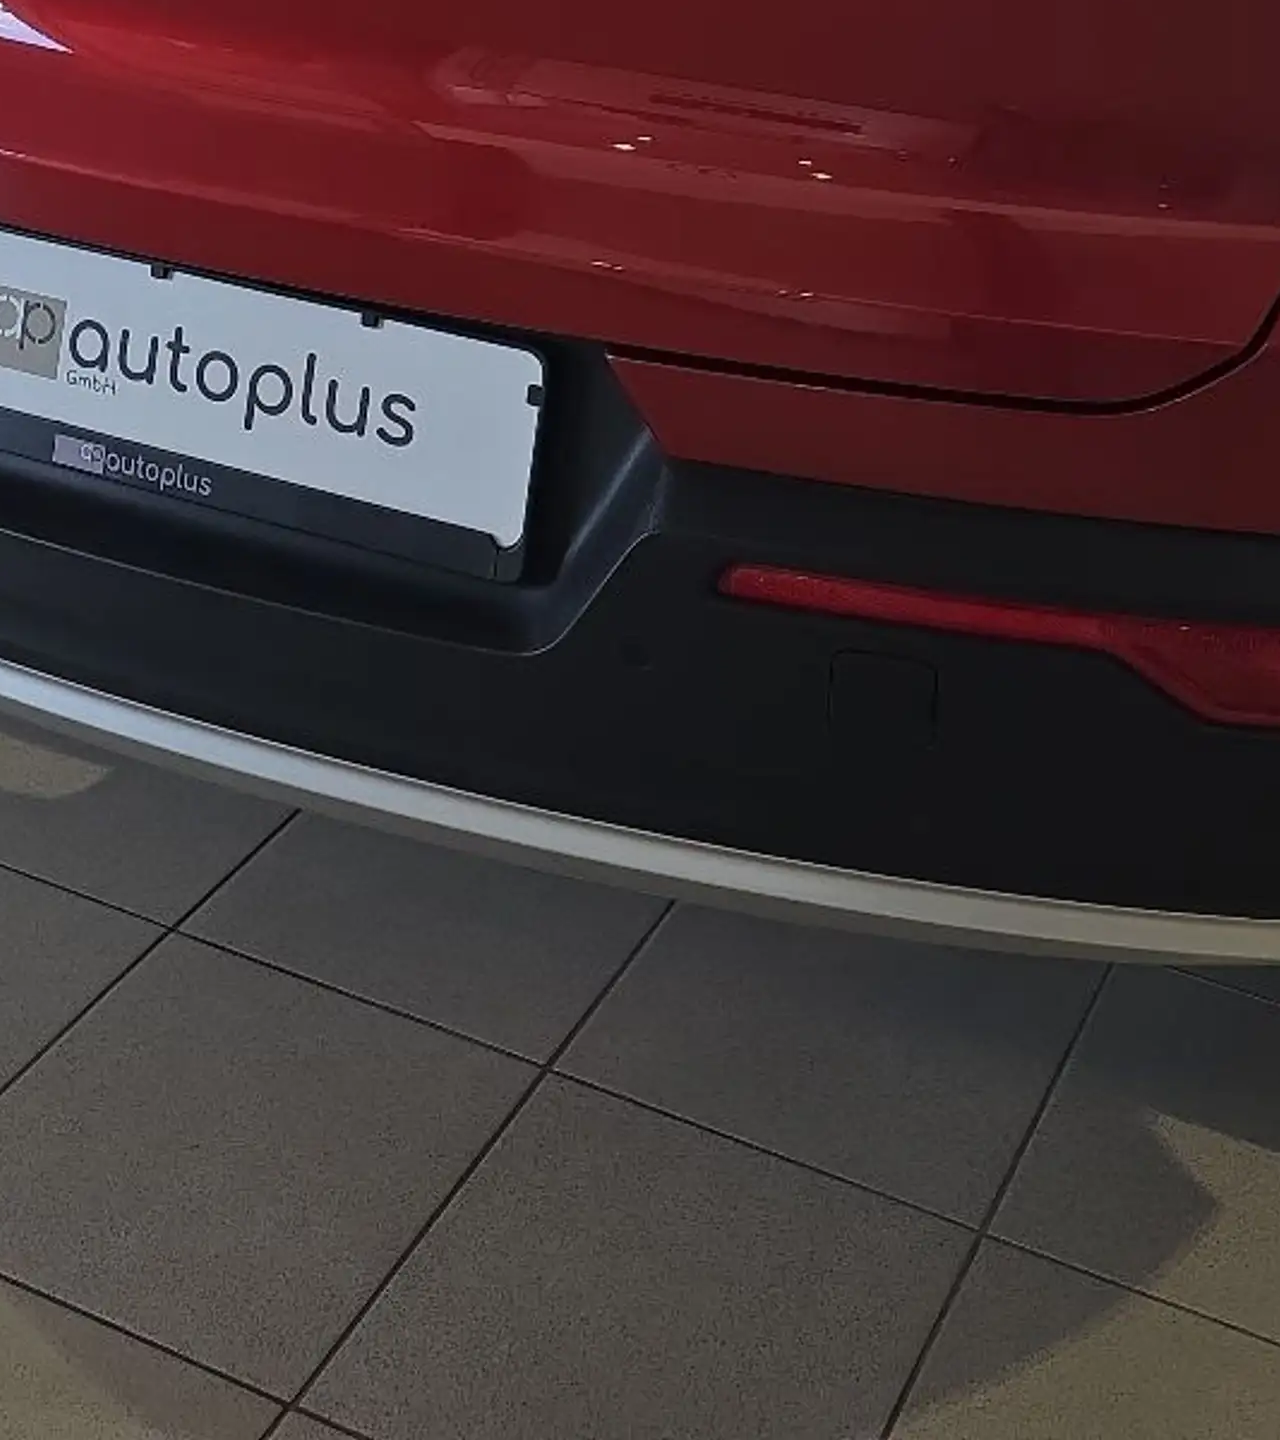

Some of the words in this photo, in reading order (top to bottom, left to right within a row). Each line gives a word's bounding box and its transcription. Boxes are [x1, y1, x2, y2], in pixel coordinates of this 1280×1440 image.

[66, 368, 117, 397] GmbH
[69, 318, 416, 447] autoplus
[106, 451, 213, 497] autoplus
